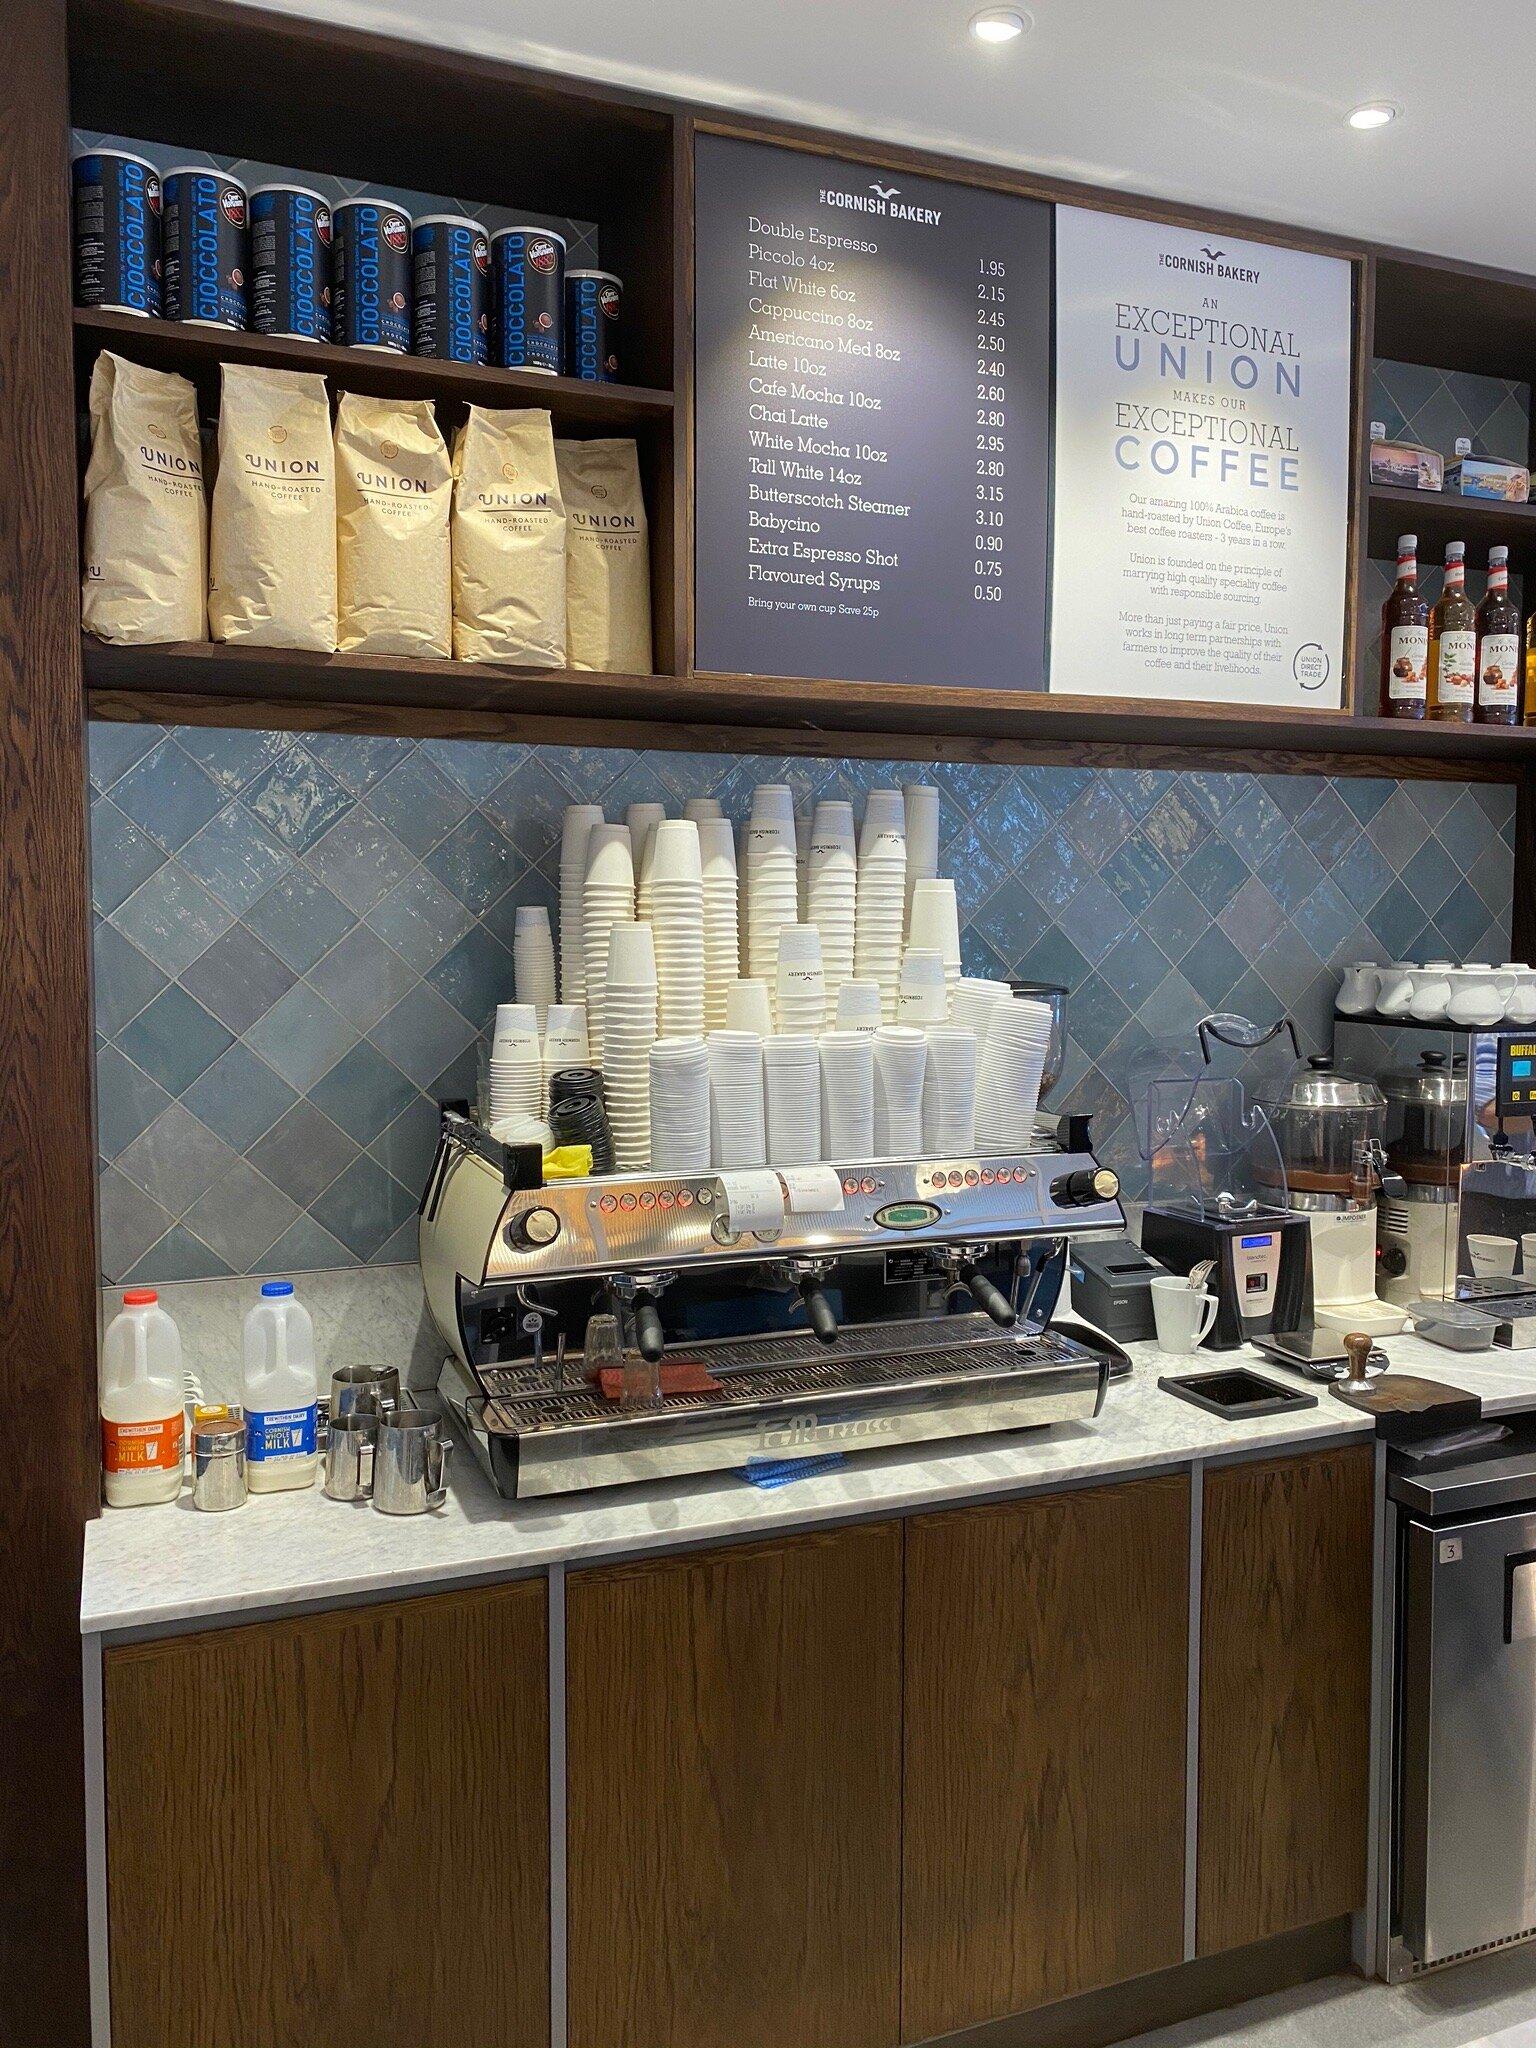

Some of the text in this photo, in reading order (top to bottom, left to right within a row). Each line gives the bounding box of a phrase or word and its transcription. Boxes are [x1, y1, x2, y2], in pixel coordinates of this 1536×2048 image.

[826, 190, 942, 226] CORNISH BAKERY
[126, 162, 145, 309] CIOCCOLATO
[748, 216, 878, 254] Double Espresso
[197, 176, 219, 319] CIOCCOLATO
[748, 242, 835, 273] Piccolo 4oz
[295, 196, 315, 336] CIOCCOLATO
[361, 206, 380, 343] CIOCCOLATO
[978, 259, 1005, 277] 1.95
[1165, 254, 1260, 284] CORNISH BAKERY
[454, 229, 473, 362] CIOCCOLATO
[748, 269, 856, 303] Flat White 6oz
[977, 284, 1005, 302] 2.15
[508, 235, 525, 365] CIOCCOLATO
[1202, 297, 1218, 310] AN
[748, 297, 874, 332] Cappuccino 8oz
[977, 309, 1005, 327] 2.45
[581, 280, 597, 382] OCCOLATO
[1115, 303, 1301, 358] EXCEPTIONAL
[747, 323, 901, 362] Americano Med 8oz
[977, 335, 1005, 352] 2.50
[748, 349, 827, 377] Latte 10oz
[977, 359, 1005, 377] 2.40
[1115, 335, 1300, 398] UNION
[749, 377, 882, 410] Cafe Mocha 10oz
[977, 384, 1005, 402] 2.60
[1173, 389, 1246, 411] MAKES OUR
[749, 403, 829, 429] Chai Latte
[976, 409, 1004, 427] 2.80
[1115, 402, 1299, 452] EXCEPTIONAL
[748, 430, 888, 463] White Mocha 10oz
[976, 435, 1004, 452] 2.95
[140, 446, 200, 473] UNION
[245, 454, 319, 474] UNION
[976, 460, 1004, 477] 2.80
[1115, 435, 1299, 492] COFFEE
[748, 456, 862, 486] Tall White 14oz
[148, 475, 204, 492] HAND-ROASTE
[165, 488, 193, 497] COFFEE
[252, 481, 321, 493] HAND-ROASTED
[357, 472, 427, 494] UNION
[976, 485, 1003, 502] 3.15
[271, 491, 303, 500] COFFEE
[479, 492, 547, 506] UNION
[748, 483, 911, 517] Butterscotch Steamer
[1128, 492, 1277, 520] Our amazing 100% Arabica coffee
[381, 507, 412, 517] COFFEE
[485, 517, 549, 525] HAND-ROASTED
[572, 513, 635, 528] UNION
[748, 510, 821, 534] Babycino
[975, 510, 1003, 527] 3.10
[1121, 506, 1292, 537] hand-roasted Union Coffee, Europe's
[579, 535, 637, 545] HAND-ROASTED
[975, 535, 1003, 552] 0.90
[1126, 522, 1286, 552] best coffee roasters 3 years row.
[748, 537, 899, 567] Extra Espresso Shot
[974, 560, 1002, 577] 0.75
[1129, 552, 1272, 579] Union founded the principle
[748, 563, 881, 594] Flavoured Syrups
[1122, 569, 1288, 592] marrying high quality speciality coffee
[974, 585, 1002, 602] 0.50
[1149, 584, 1262, 606] with responsible sourcing.
[748, 596, 880, 619] Bring your own cup Save 25p
[1118, 610, 1289, 635] More than just paying fair price, Union
[1125, 627, 1282, 649] works long term partnerships with
[1122, 640, 1283, 662] farmers improve the quality their
[1144, 657, 1262, 675] coffee and their livelihoods.
[1510, 1045, 1536, 1056] BUFFAL
[265, 1426, 290, 1434] CORNISH
[265, 1432, 289, 1440] WHOLE
[265, 1438, 290, 1450] MILK
[119, 1452, 144, 1462] MILK
[1447, 1544, 1455, 1558] 3
